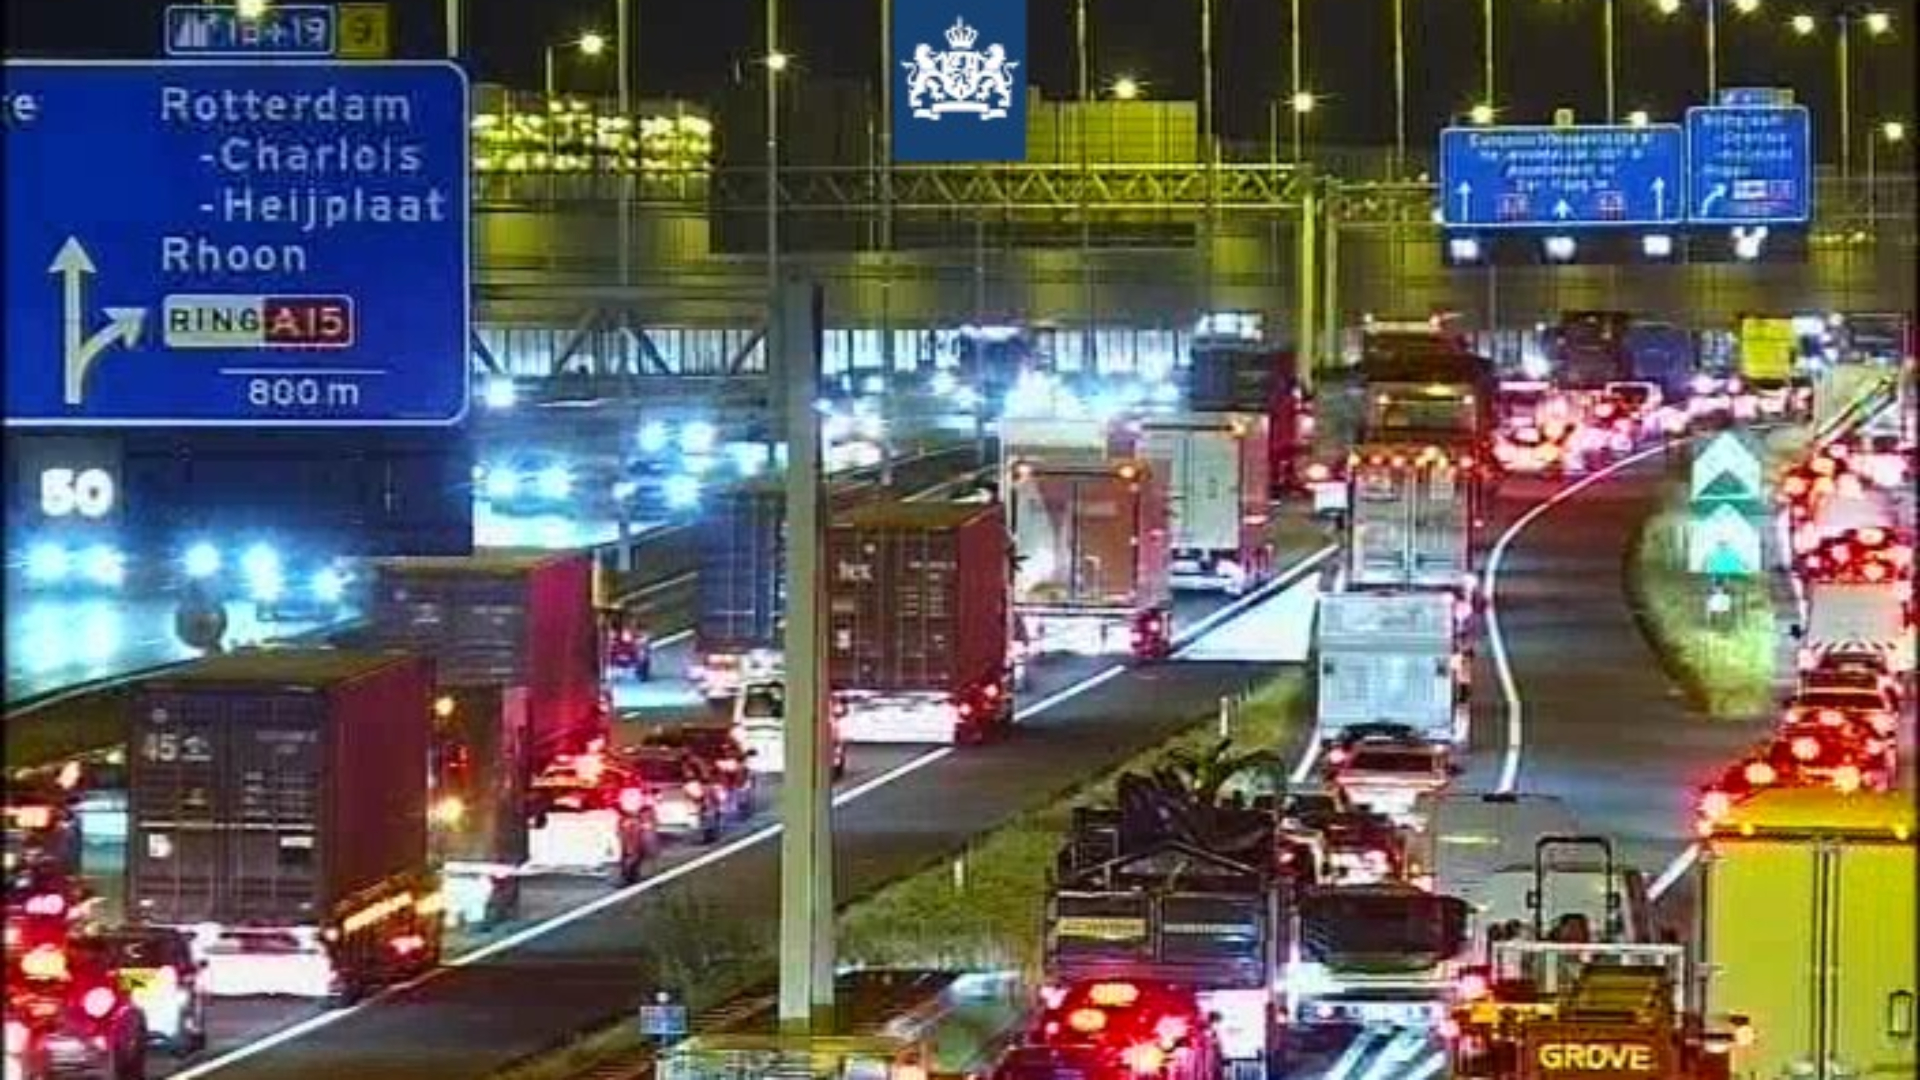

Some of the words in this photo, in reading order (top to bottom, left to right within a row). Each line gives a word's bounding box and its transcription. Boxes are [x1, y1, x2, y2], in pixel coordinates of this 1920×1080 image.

[161, 87, 411, 121] Rotterdam
[161, 237, 306, 272] Rhoon
[169, 307, 260, 333] RING
[272, 308, 345, 335] A15
[249, 379, 320, 405] 800
[329, 384, 360, 405] m
[41, 469, 113, 516] 50
[1539, 1043, 1652, 1070] GROVE
